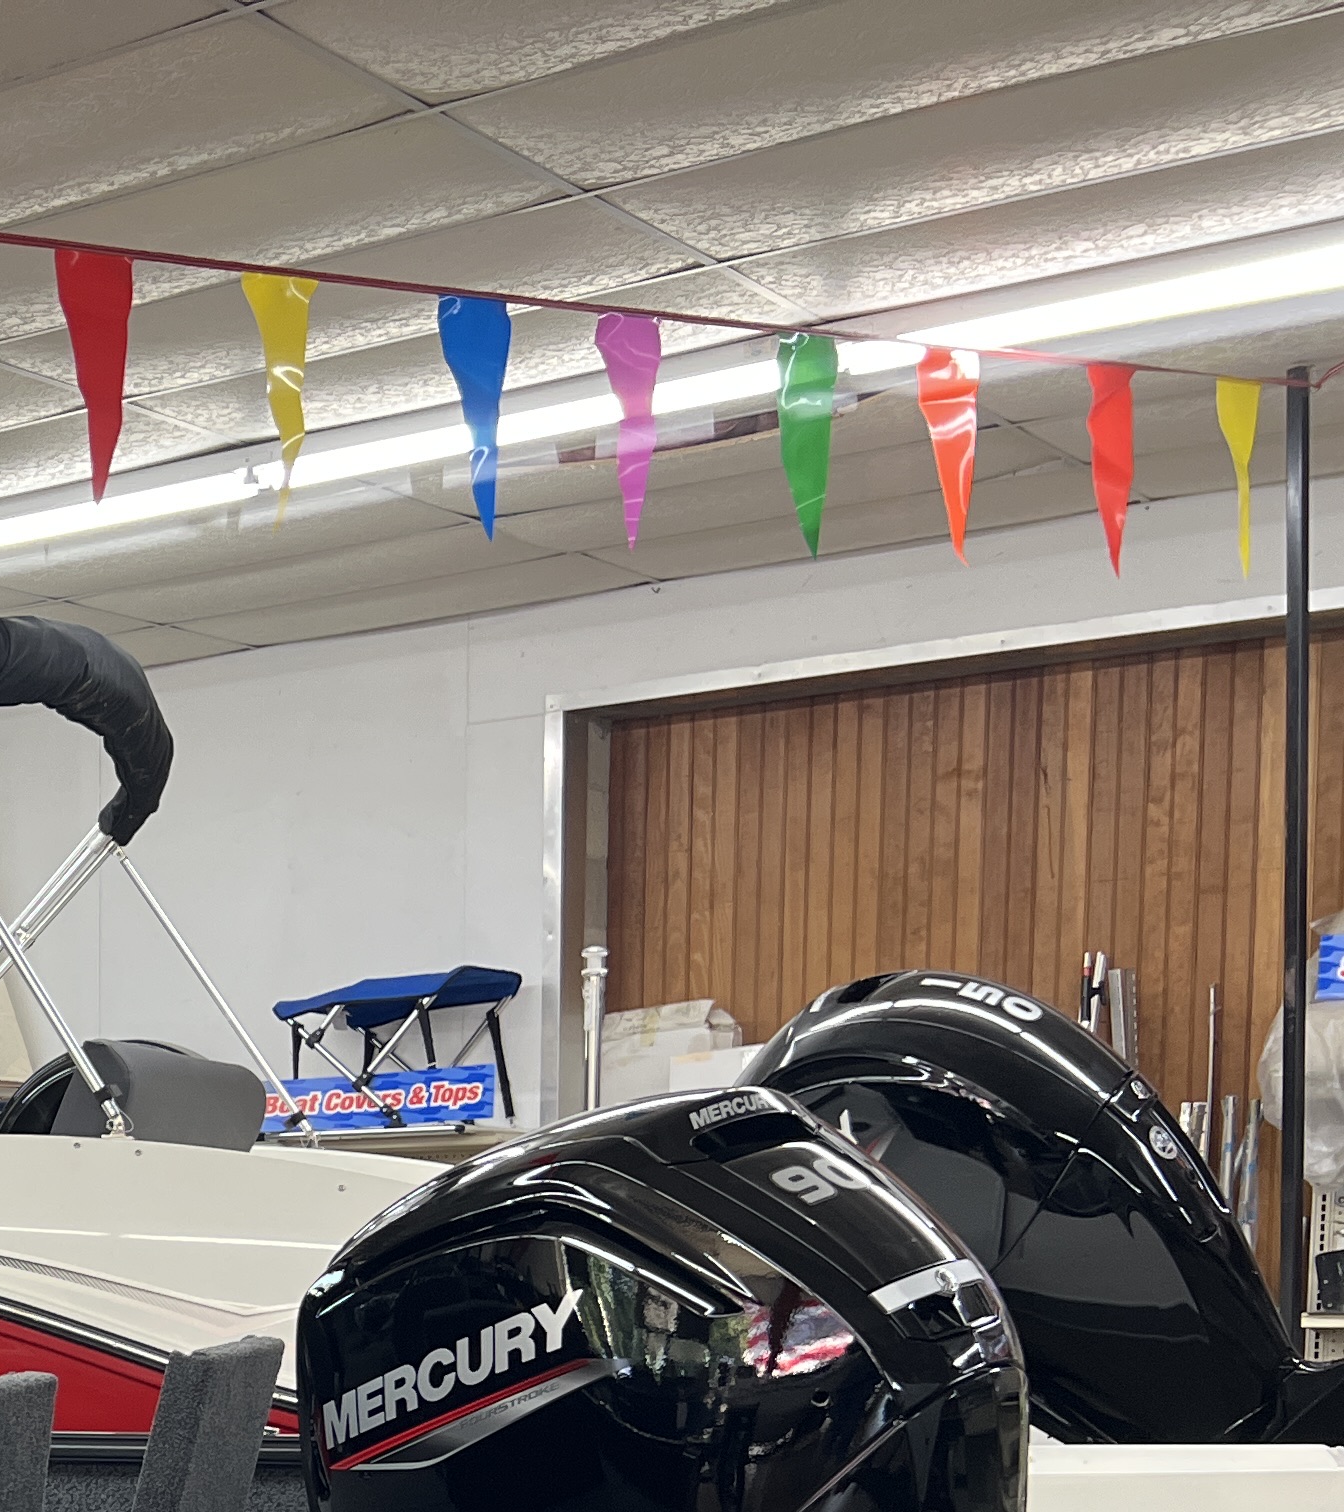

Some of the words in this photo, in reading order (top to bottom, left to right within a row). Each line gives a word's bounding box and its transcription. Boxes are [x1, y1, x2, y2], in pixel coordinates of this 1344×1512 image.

[920, 977, 1044, 1022] 150
[408, 1085, 426, 1105] &
[432, 1083, 481, 1107] Tops
[689, 1092, 774, 1130] MERCUR
[769, 1157, 869, 1206] 90
[322, 1289, 585, 1450] MERCURY
